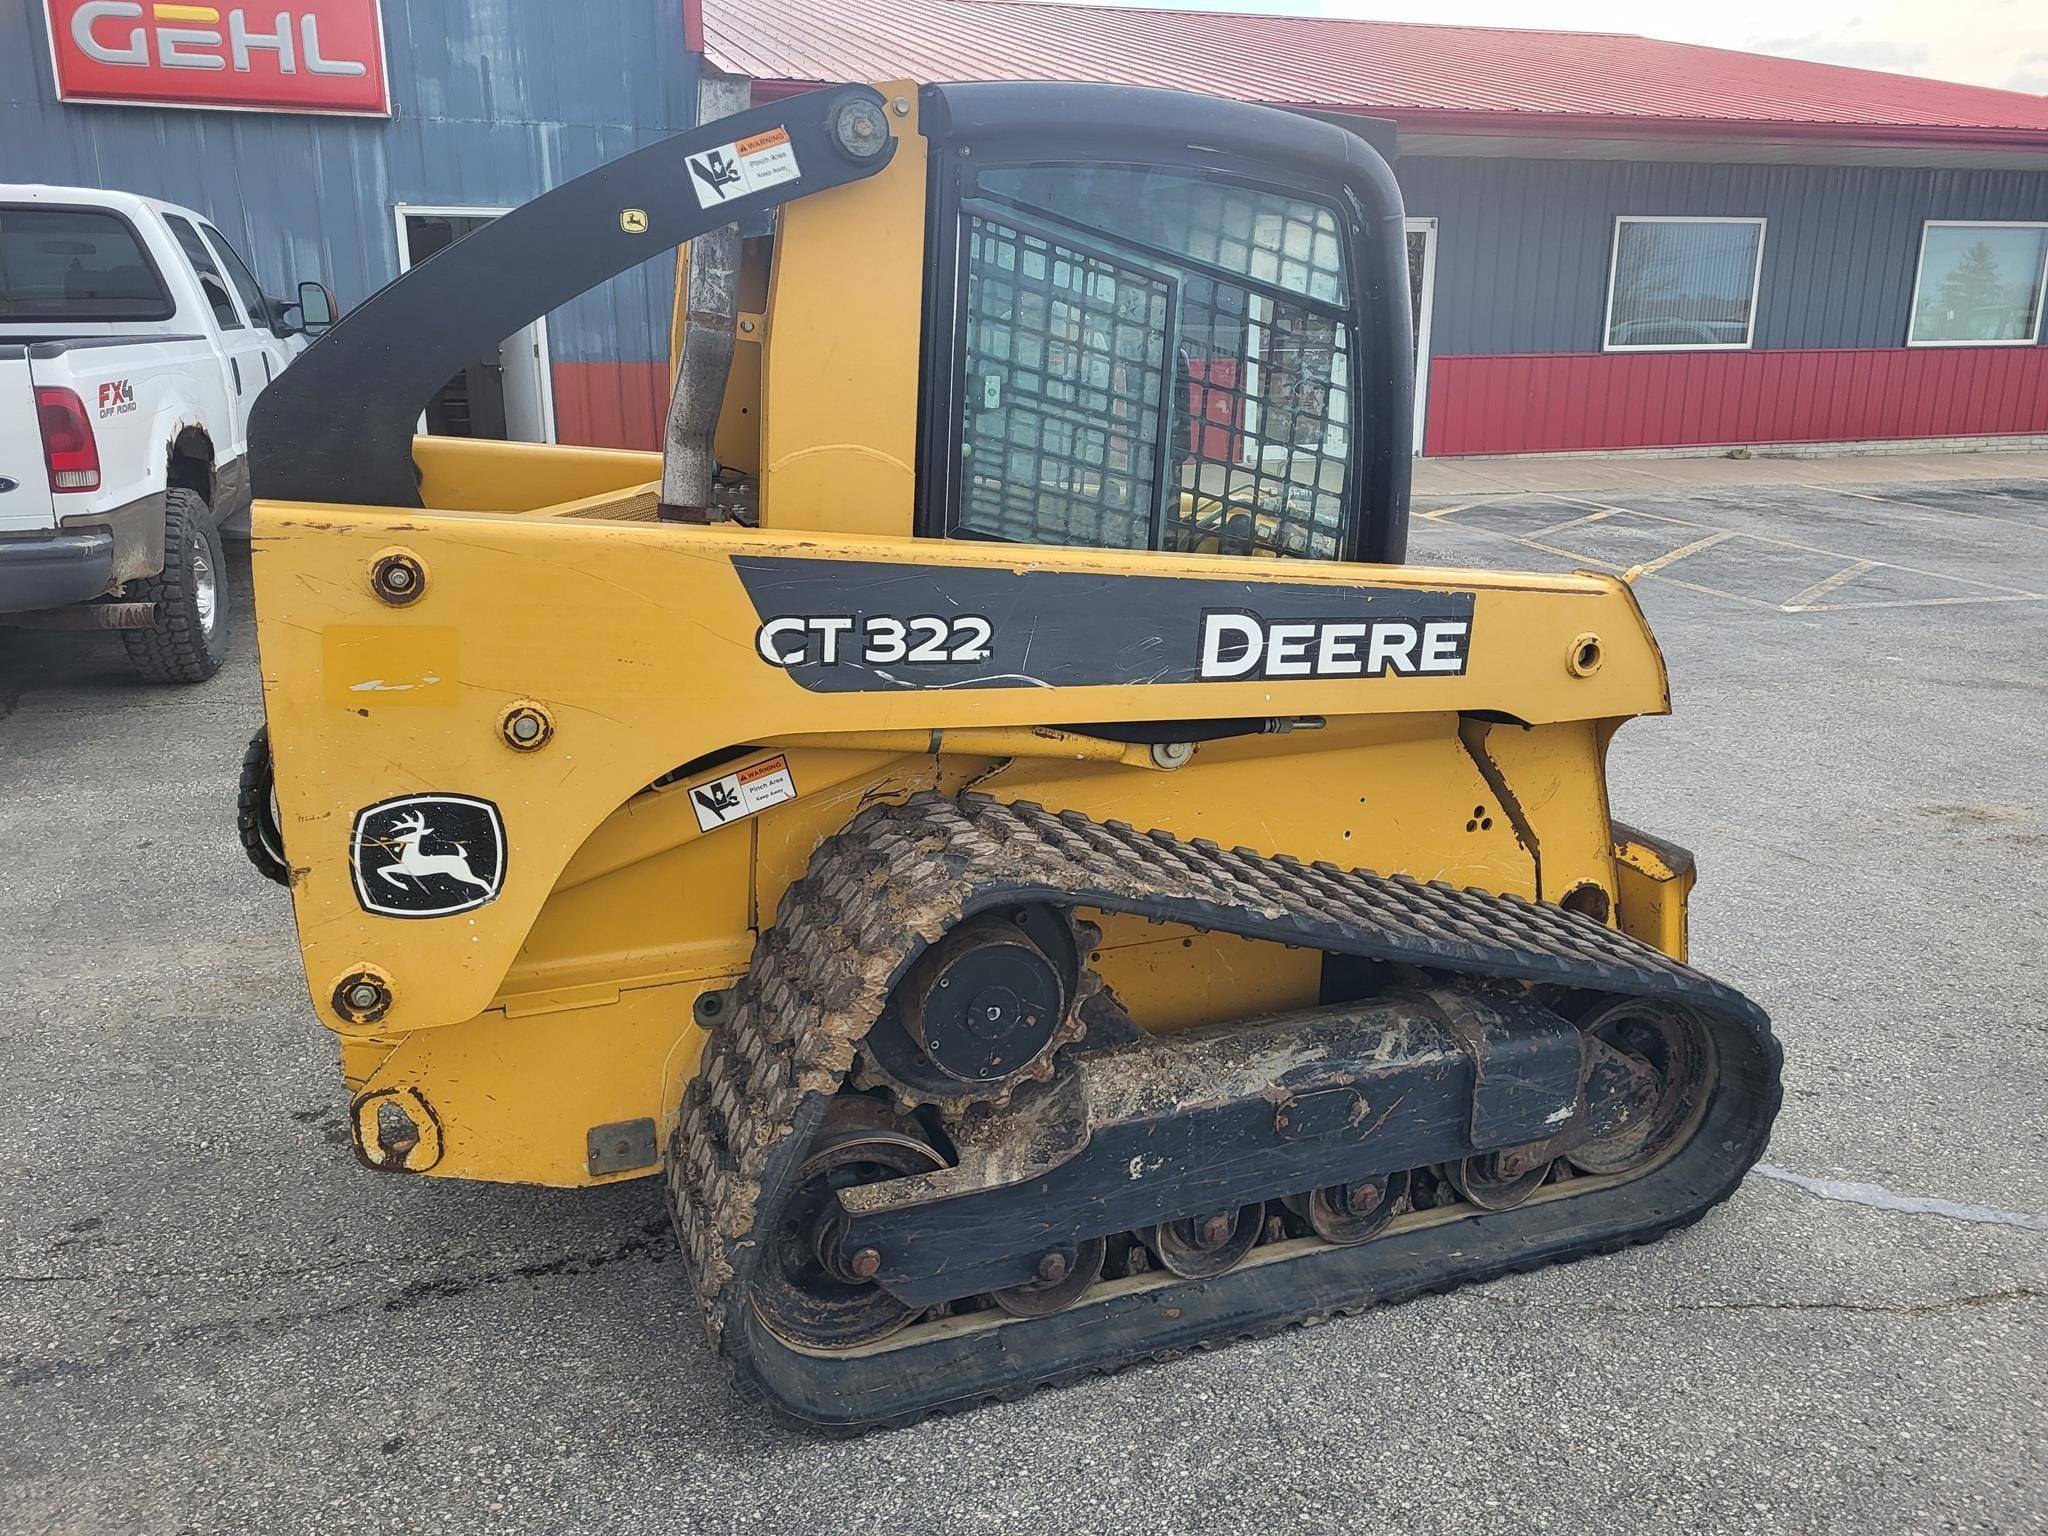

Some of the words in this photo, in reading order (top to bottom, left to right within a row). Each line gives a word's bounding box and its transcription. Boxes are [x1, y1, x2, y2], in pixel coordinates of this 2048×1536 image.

[70, 0, 367, 77] GEHL
[748, 132, 784, 149] WARNING
[99, 379, 134, 409] FX4
[100, 407, 115, 418] OFF
[116, 402, 137, 415] ROAD
[758, 616, 853, 665] CT
[864, 616, 993, 664] 322
[1201, 613, 1468, 677] DEERE
[748, 761, 782, 778] WARNING
[749, 783, 768, 793] Pinch
[769, 777, 784, 786] Area
[756, 793, 769, 801] Keep
[770, 788, 784, 797] Away
